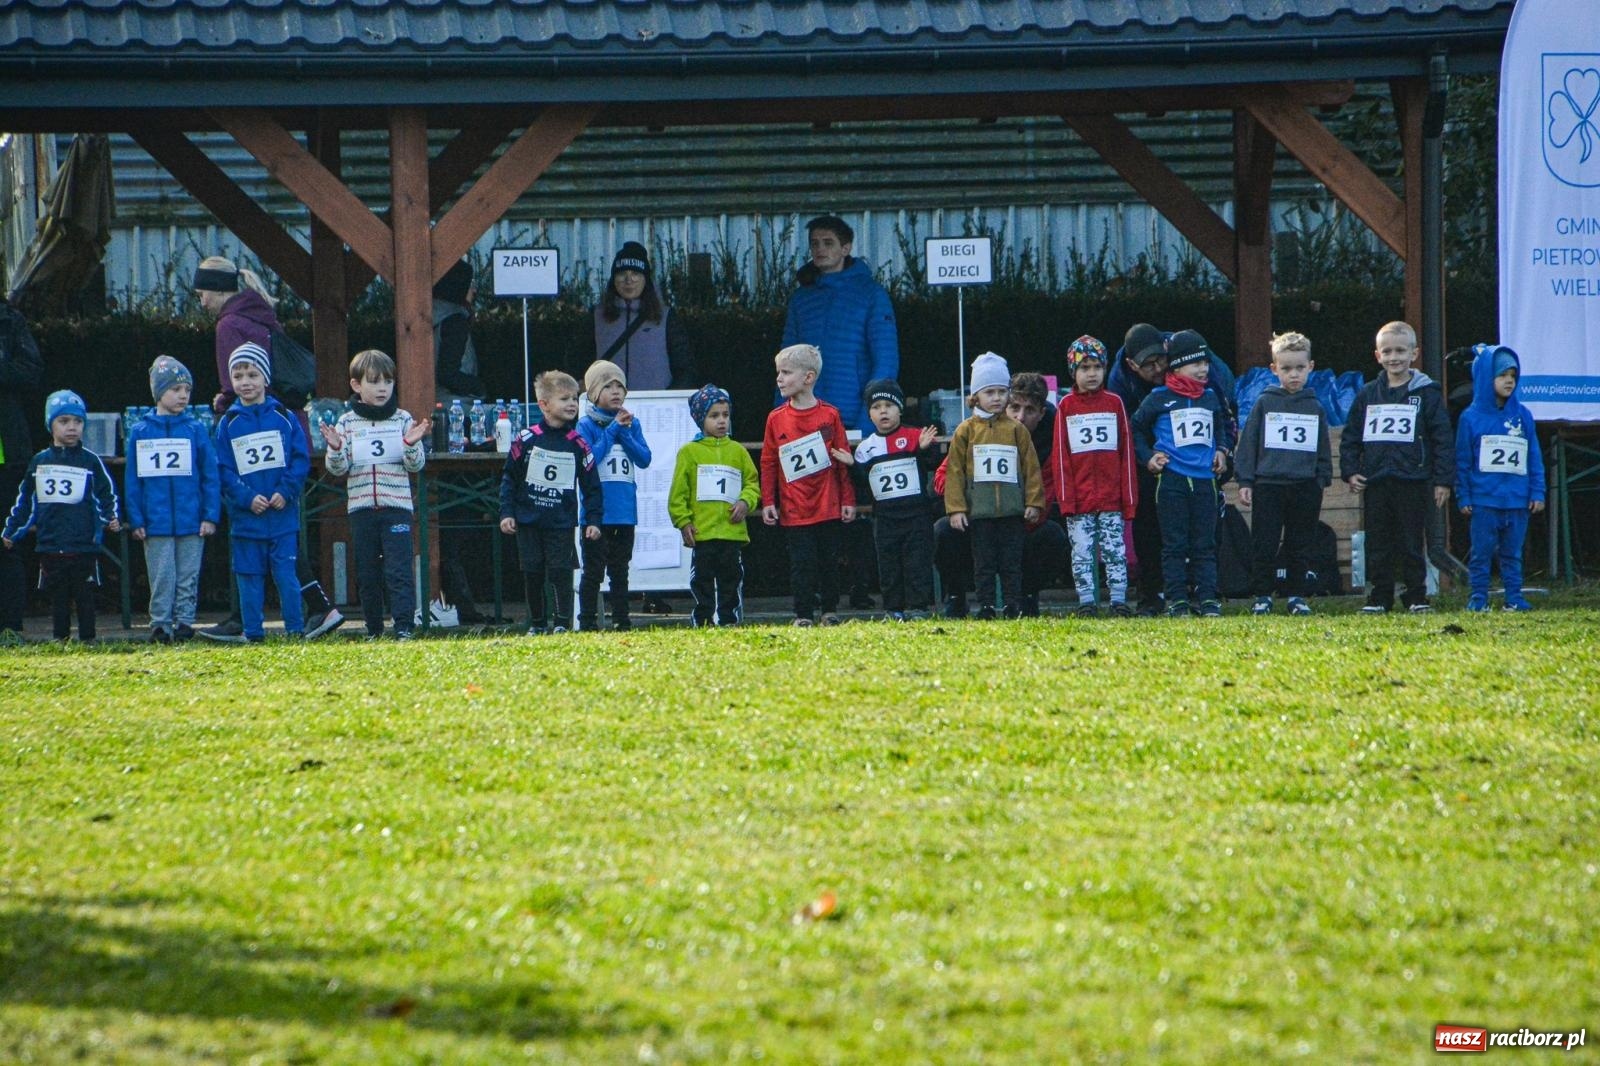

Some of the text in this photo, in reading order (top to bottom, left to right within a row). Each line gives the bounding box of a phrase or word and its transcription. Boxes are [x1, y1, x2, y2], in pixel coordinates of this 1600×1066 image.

[941, 244, 976, 256] BIEGI
[1532, 248, 1600, 266] PIETRO
[503, 255, 548, 267] ZAPISY
[938, 265, 980, 278] DZIECI
[1551, 279, 1600, 296] WIEL
[1079, 426, 1108, 444] 35
[1176, 420, 1211, 439] 121
[1277, 425, 1307, 443] 13
[1368, 417, 1411, 435] 123
[245, 445, 275, 465] 32
[371, 440, 385, 457] 3
[1490, 448, 1520, 467] 24
[150, 451, 180, 469] 12
[607, 457, 630, 475] 19
[790, 448, 818, 472] 21
[982, 457, 1009, 475] 16
[544, 464, 557, 481] 6
[45, 479, 73, 496] 33
[716, 478, 726, 494] 1
[879, 472, 909, 493] 29
